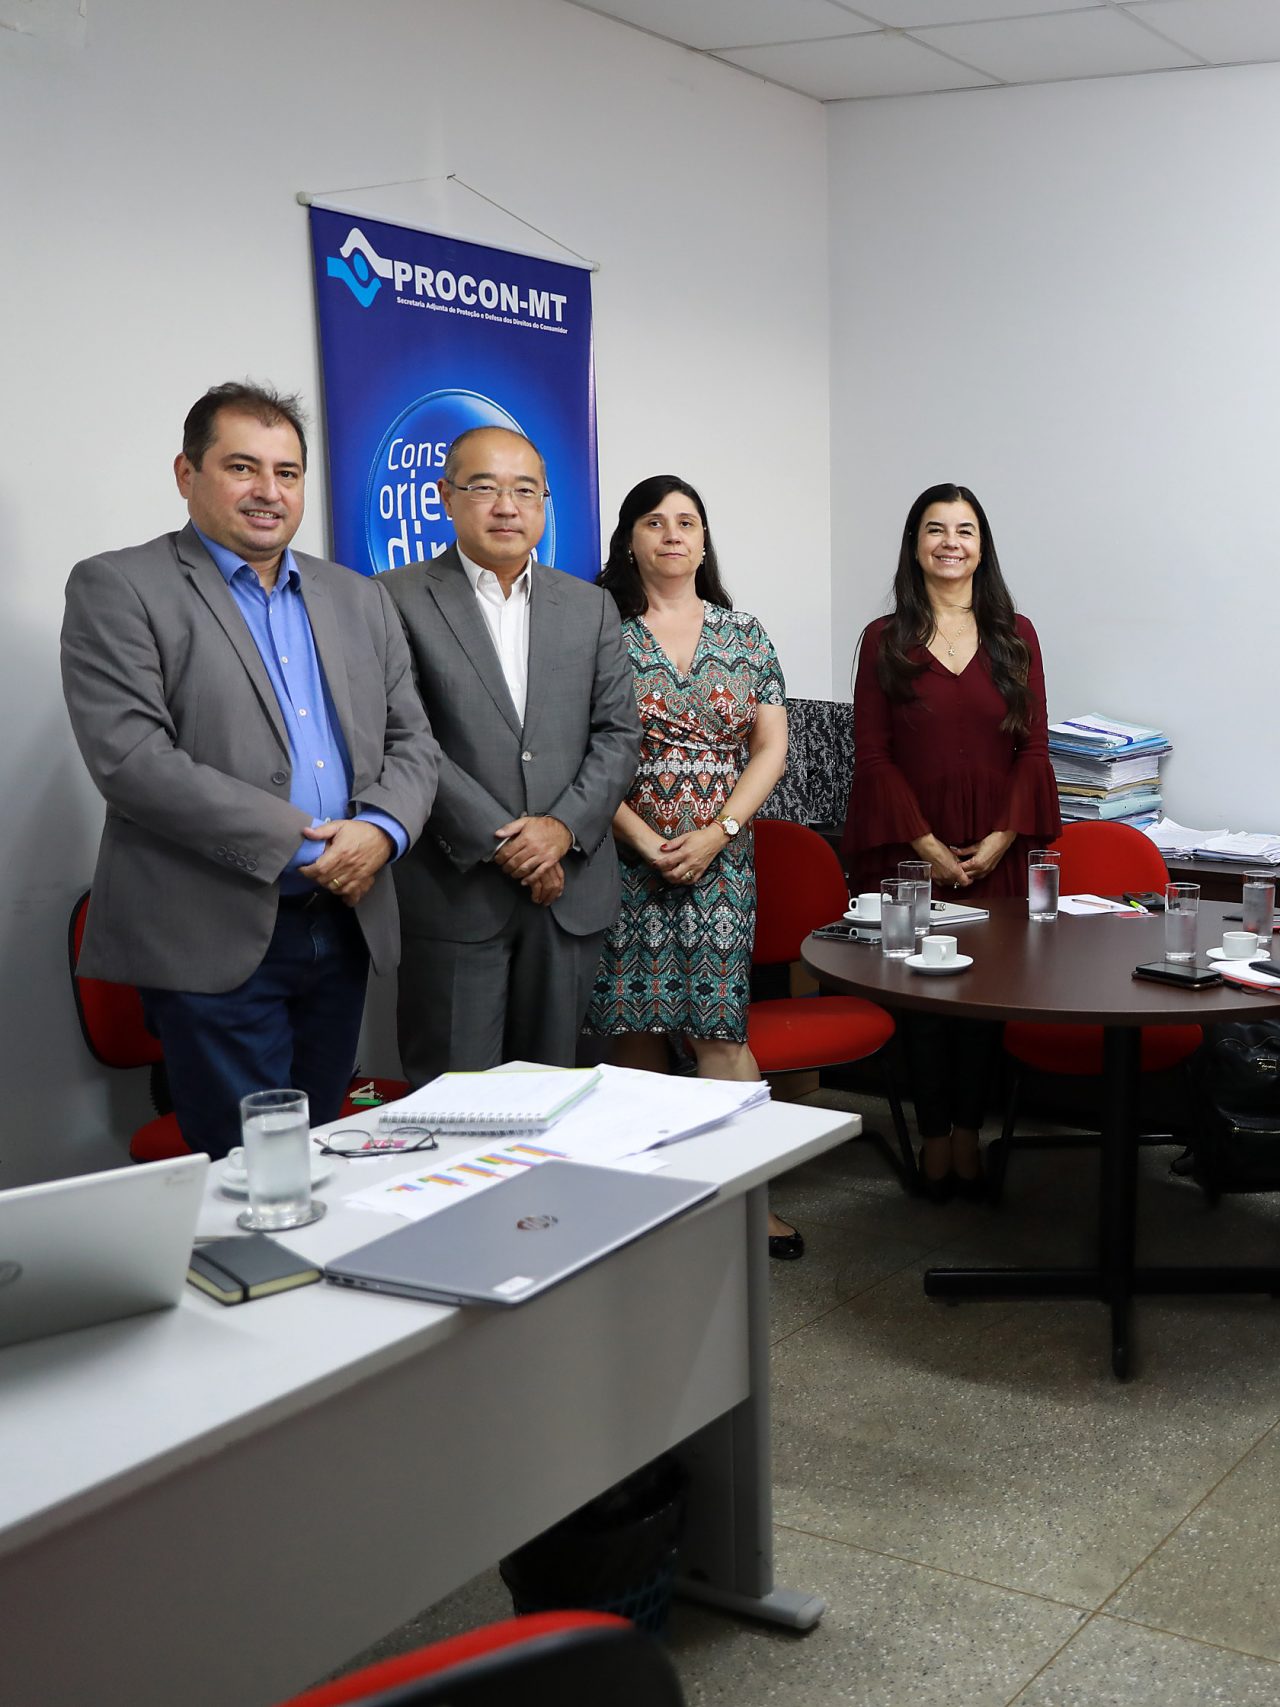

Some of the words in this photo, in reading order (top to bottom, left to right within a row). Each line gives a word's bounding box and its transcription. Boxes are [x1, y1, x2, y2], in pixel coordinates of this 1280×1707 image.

[394, 260, 567, 322] PROCON-MT
[397, 296, 425, 308] Secretaria
[426, 302, 448, 312] Adjunta
[449, 306, 456, 314] de
[457, 308, 480, 318] Proteção
[485, 313, 502, 322] Defesa
[503, 316, 513, 324] dos
[513, 318, 532, 328] Direitos
[540, 323, 568, 334] Consumidor
[388, 438, 452, 471] Cons
[379, 469, 453, 521] orie
